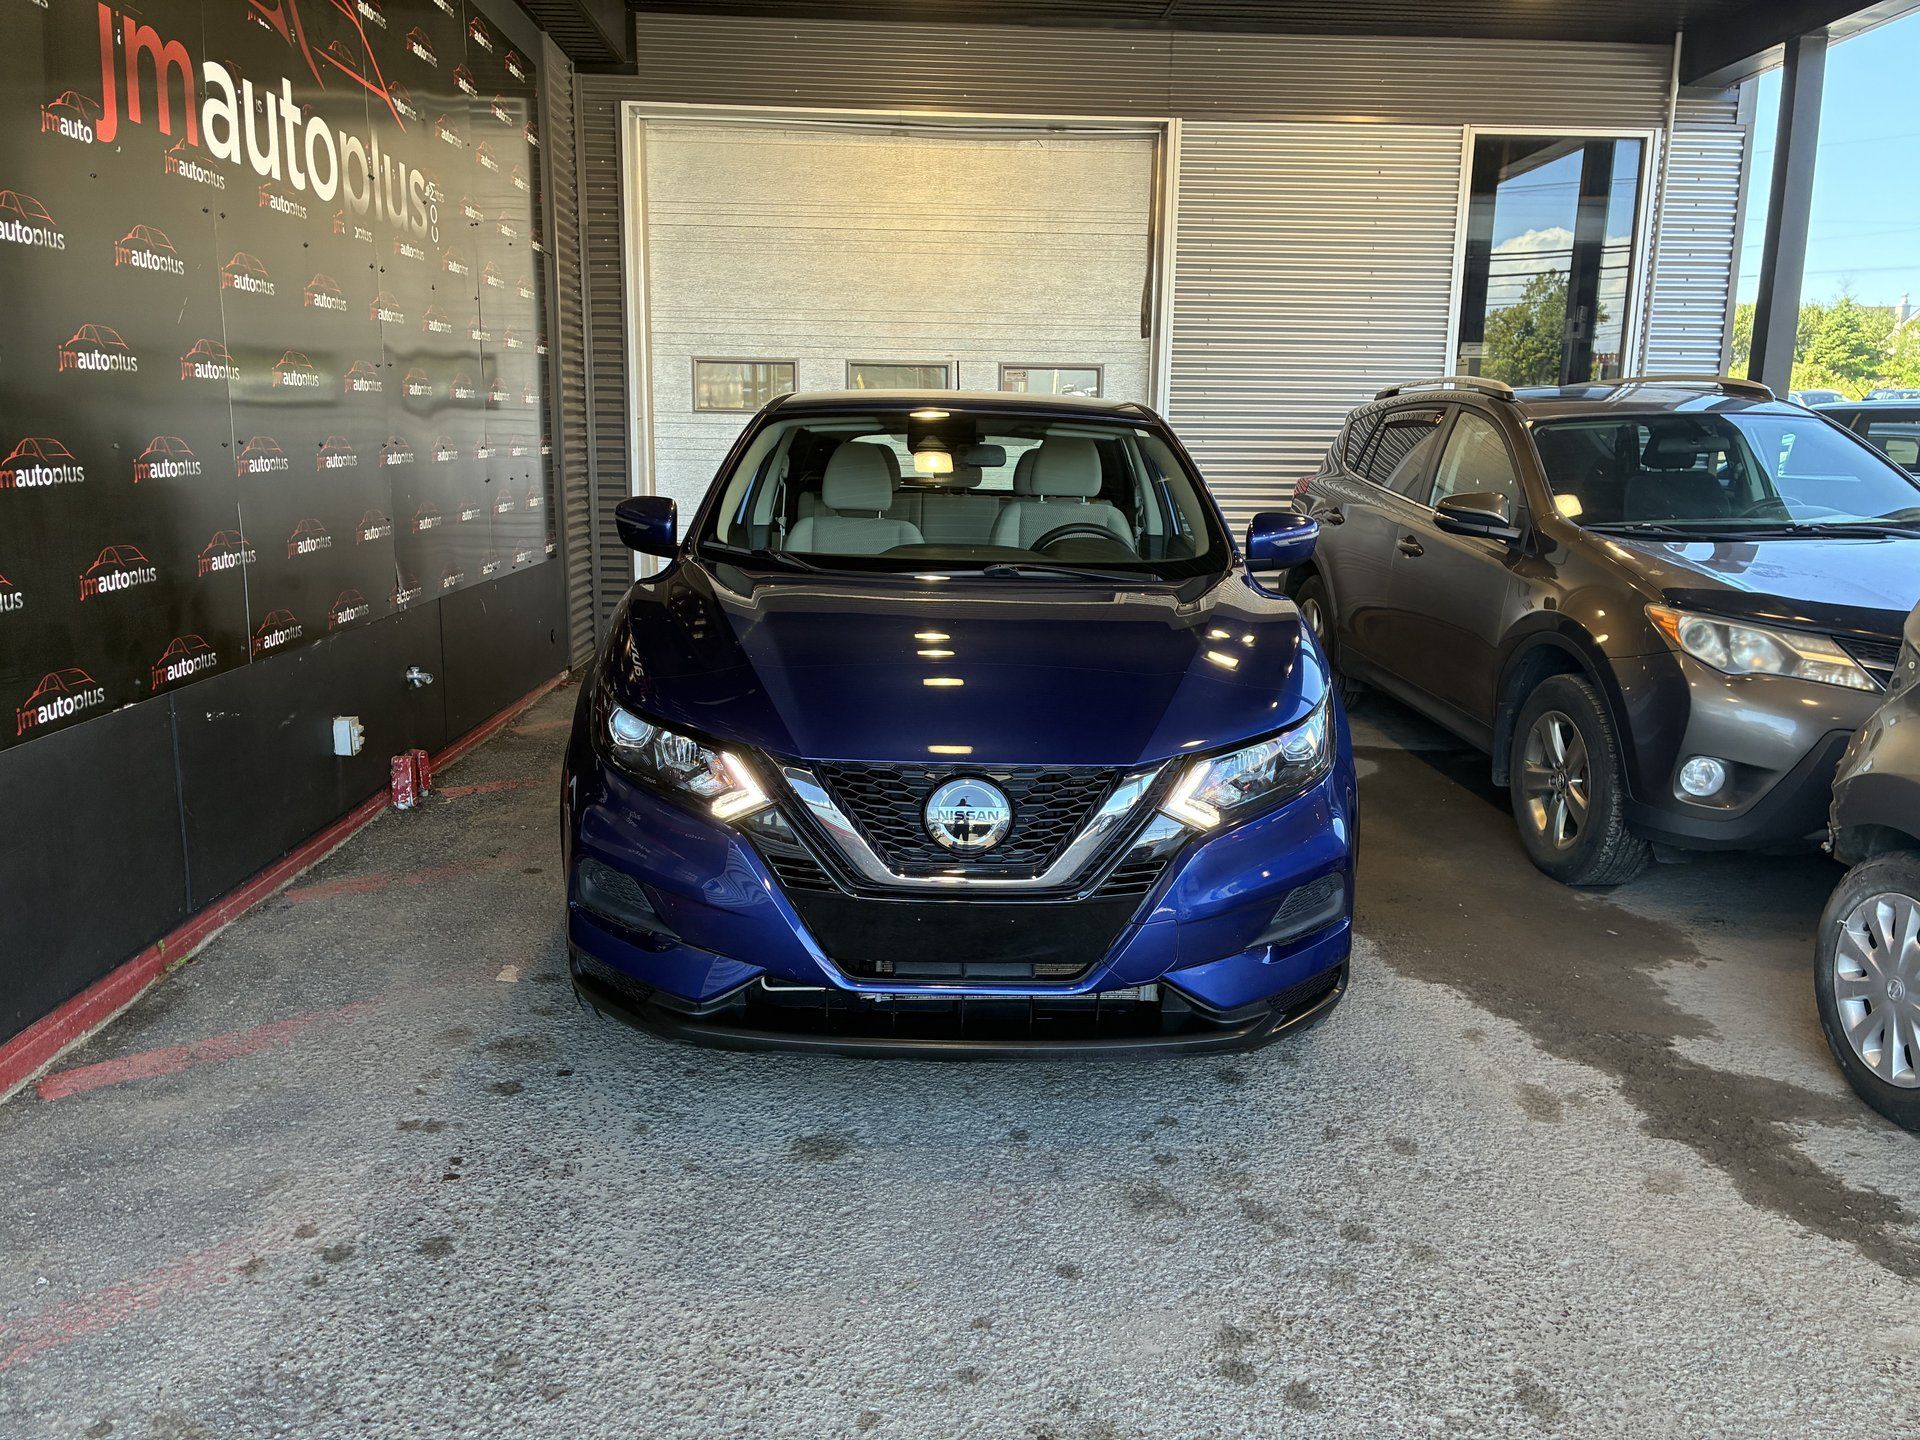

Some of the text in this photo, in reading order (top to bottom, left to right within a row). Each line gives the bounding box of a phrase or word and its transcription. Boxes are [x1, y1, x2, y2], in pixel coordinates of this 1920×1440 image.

[114, 240, 184, 276] jmautoplus
[221, 267, 275, 296] jmautoplus
[59, 345, 138, 373] jmautoplus
[180, 356, 240, 381] jmautoplus
[133, 457, 202, 484] jmautoplus
[236, 454, 289, 478] jmautoplus
[287, 535, 332, 559] jmautoplus
[197, 548, 257, 577] jmautoplus
[79, 566, 157, 602] jmautoplus
[151, 651, 217, 690] jmautoplus
[16, 687, 105, 736] jmautoplus
[937, 811, 999, 821] NISSAN
